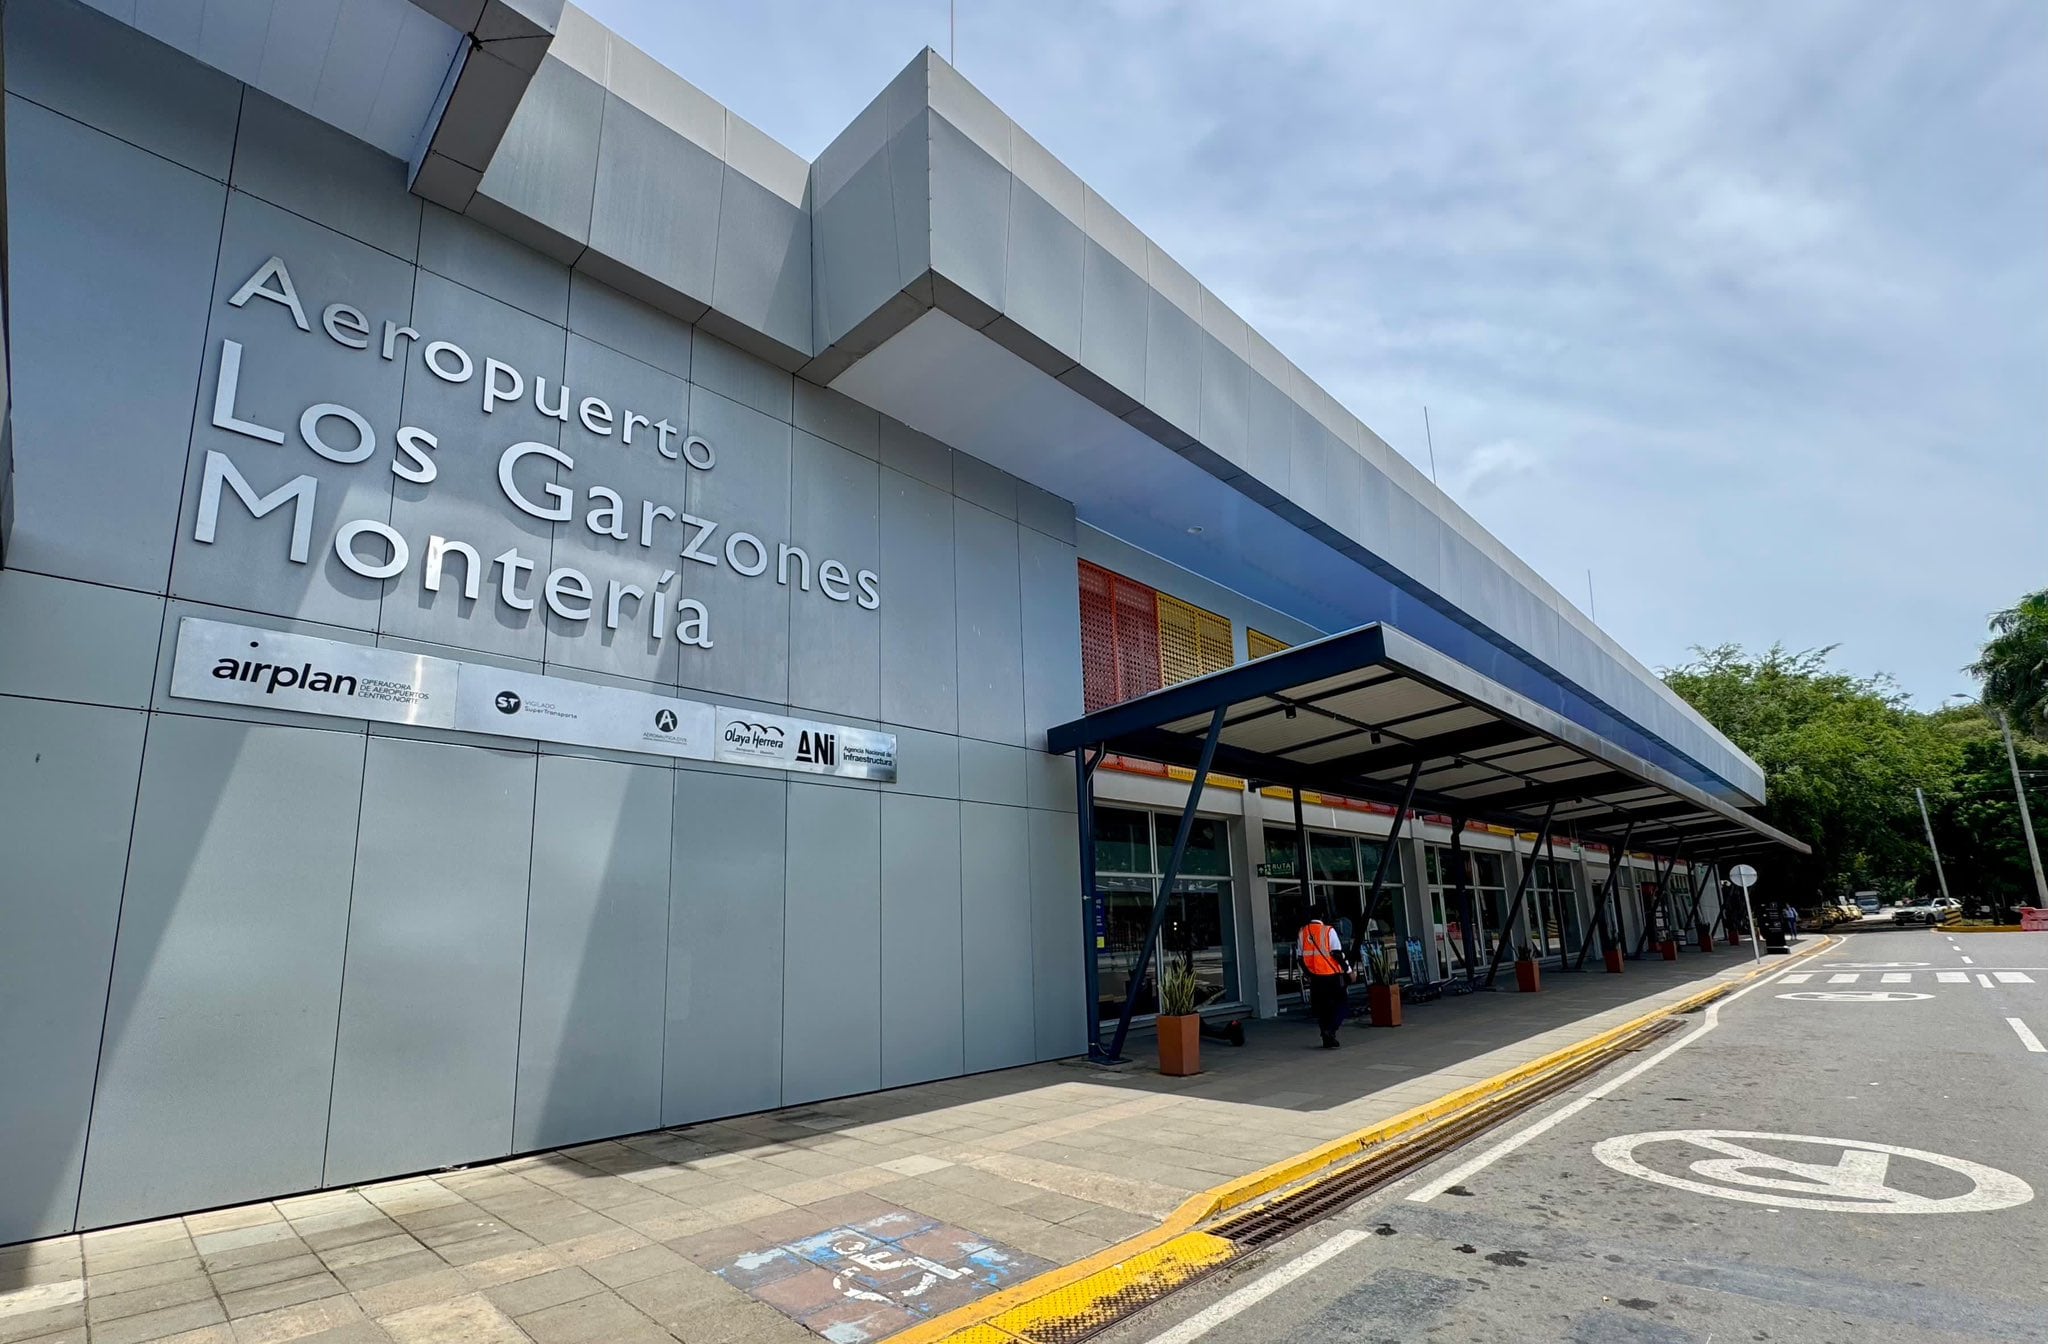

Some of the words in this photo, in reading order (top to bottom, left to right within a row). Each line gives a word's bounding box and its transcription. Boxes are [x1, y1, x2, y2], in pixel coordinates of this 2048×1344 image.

[227, 256, 718, 471] Aeropuerto
[211, 339, 440, 484] Los
[498, 441, 881, 611] Garzones
[194, 450, 715, 650] Montería
[212, 641, 358, 696] airplan
[359, 684, 372, 692] DE
[373, 688, 429, 699] AEROPUERTOS
[361, 679, 411, 690] OPERADORA
[358, 691, 392, 701] CENTRO
[393, 696, 418, 704] NORTE
[497, 697, 518, 708] ST
[724, 727, 751, 747] Olaya
[752, 730, 784, 749] Herrera
[843, 752, 893, 767] Infraestructura
